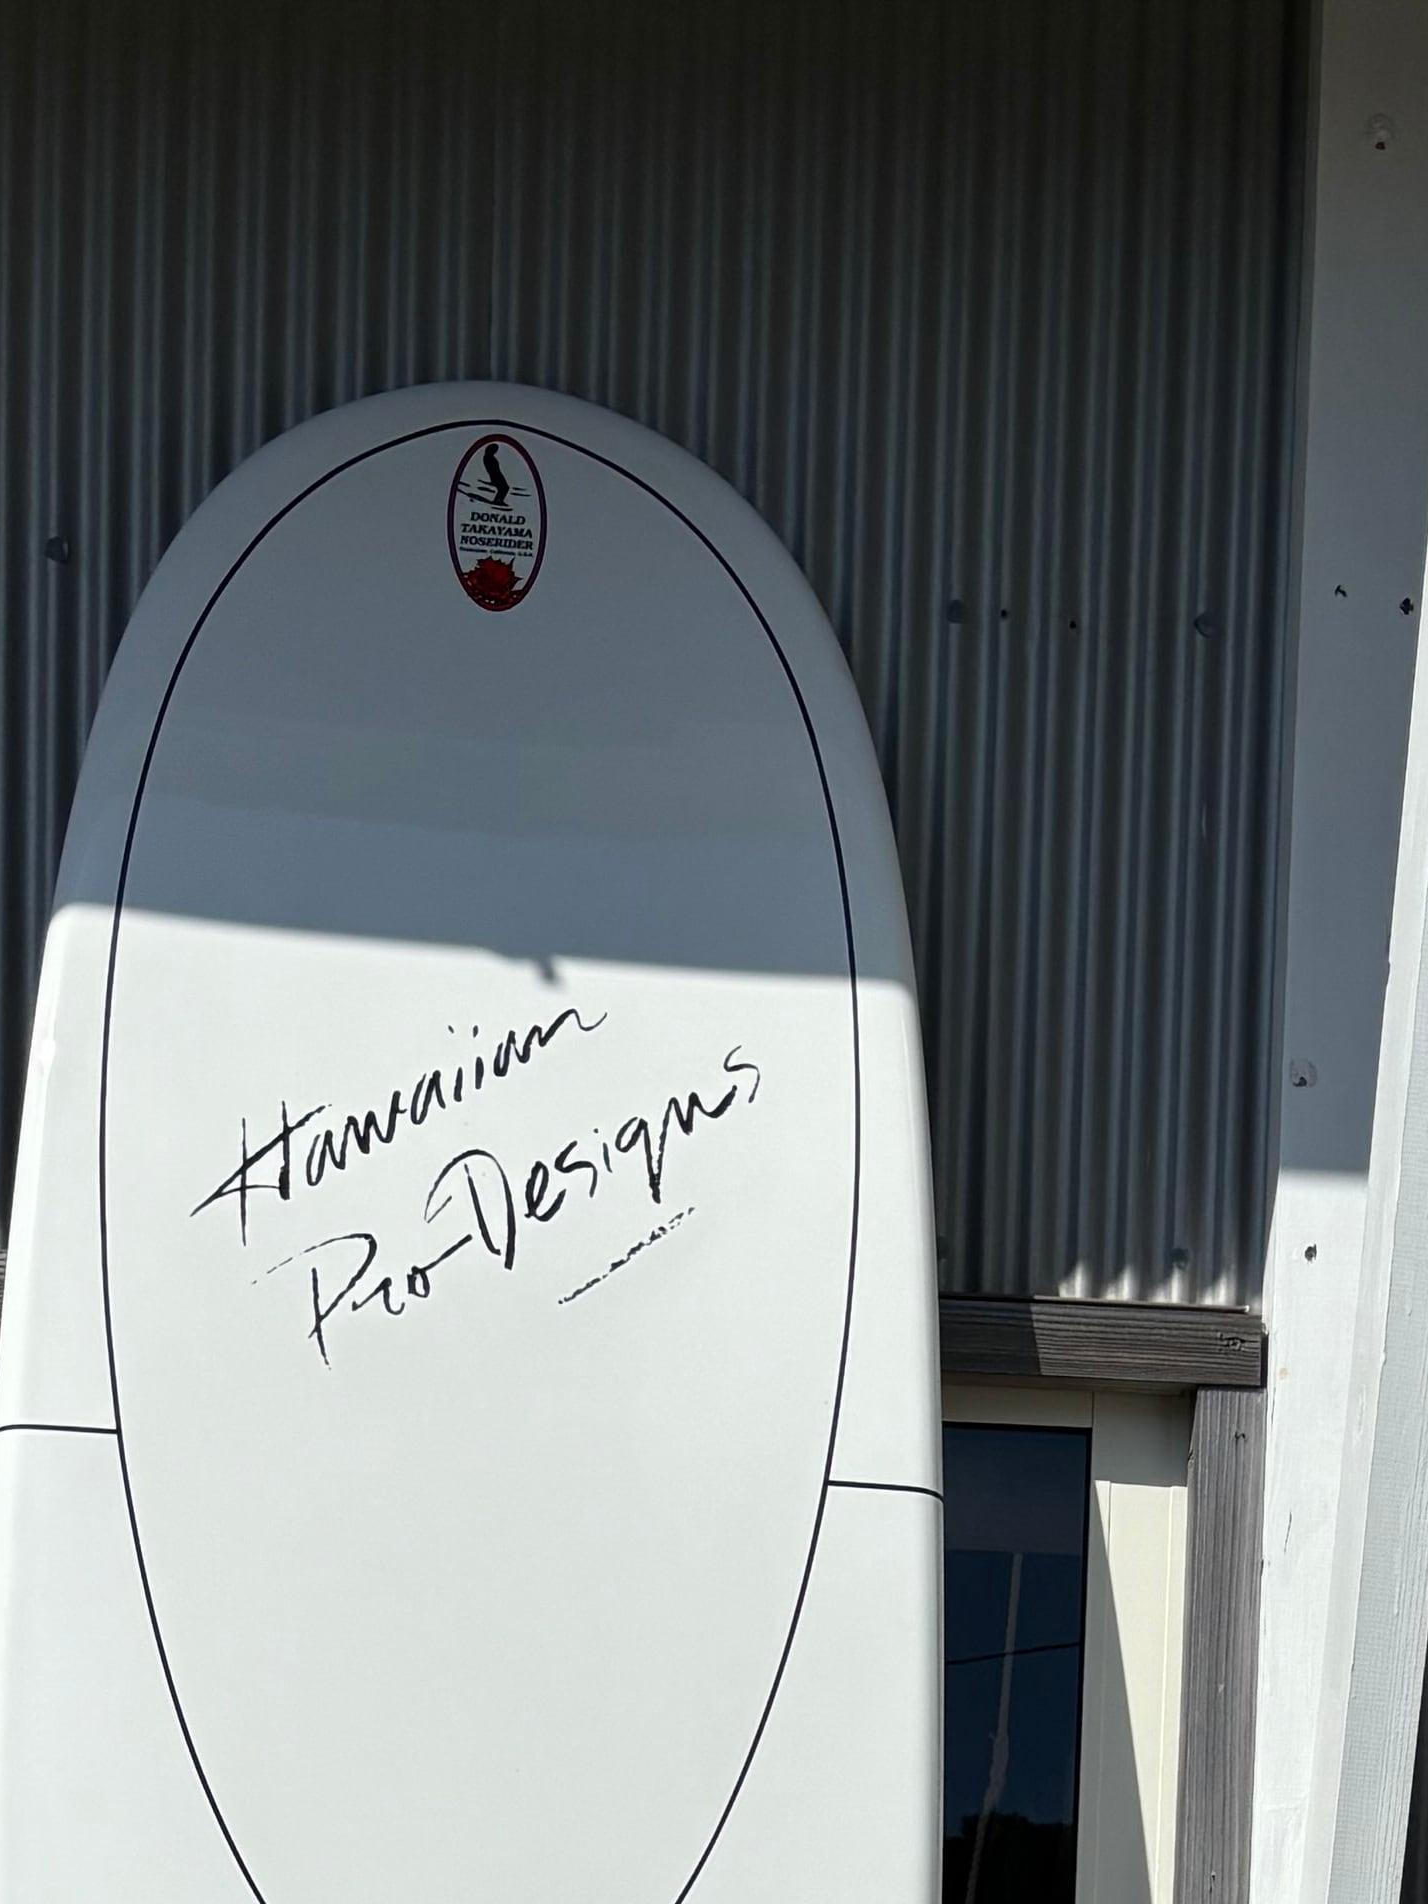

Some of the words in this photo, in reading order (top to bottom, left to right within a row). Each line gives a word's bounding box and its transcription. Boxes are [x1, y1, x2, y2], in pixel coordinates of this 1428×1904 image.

[470, 512, 526, 526] DONALD
[460, 523, 533, 539] TAKAYAMA
[459, 535, 533, 551] NOSERIDER
[192, 1007, 608, 1245] Hawaiian
[251, 1045, 762, 1370] Pro-Designs
